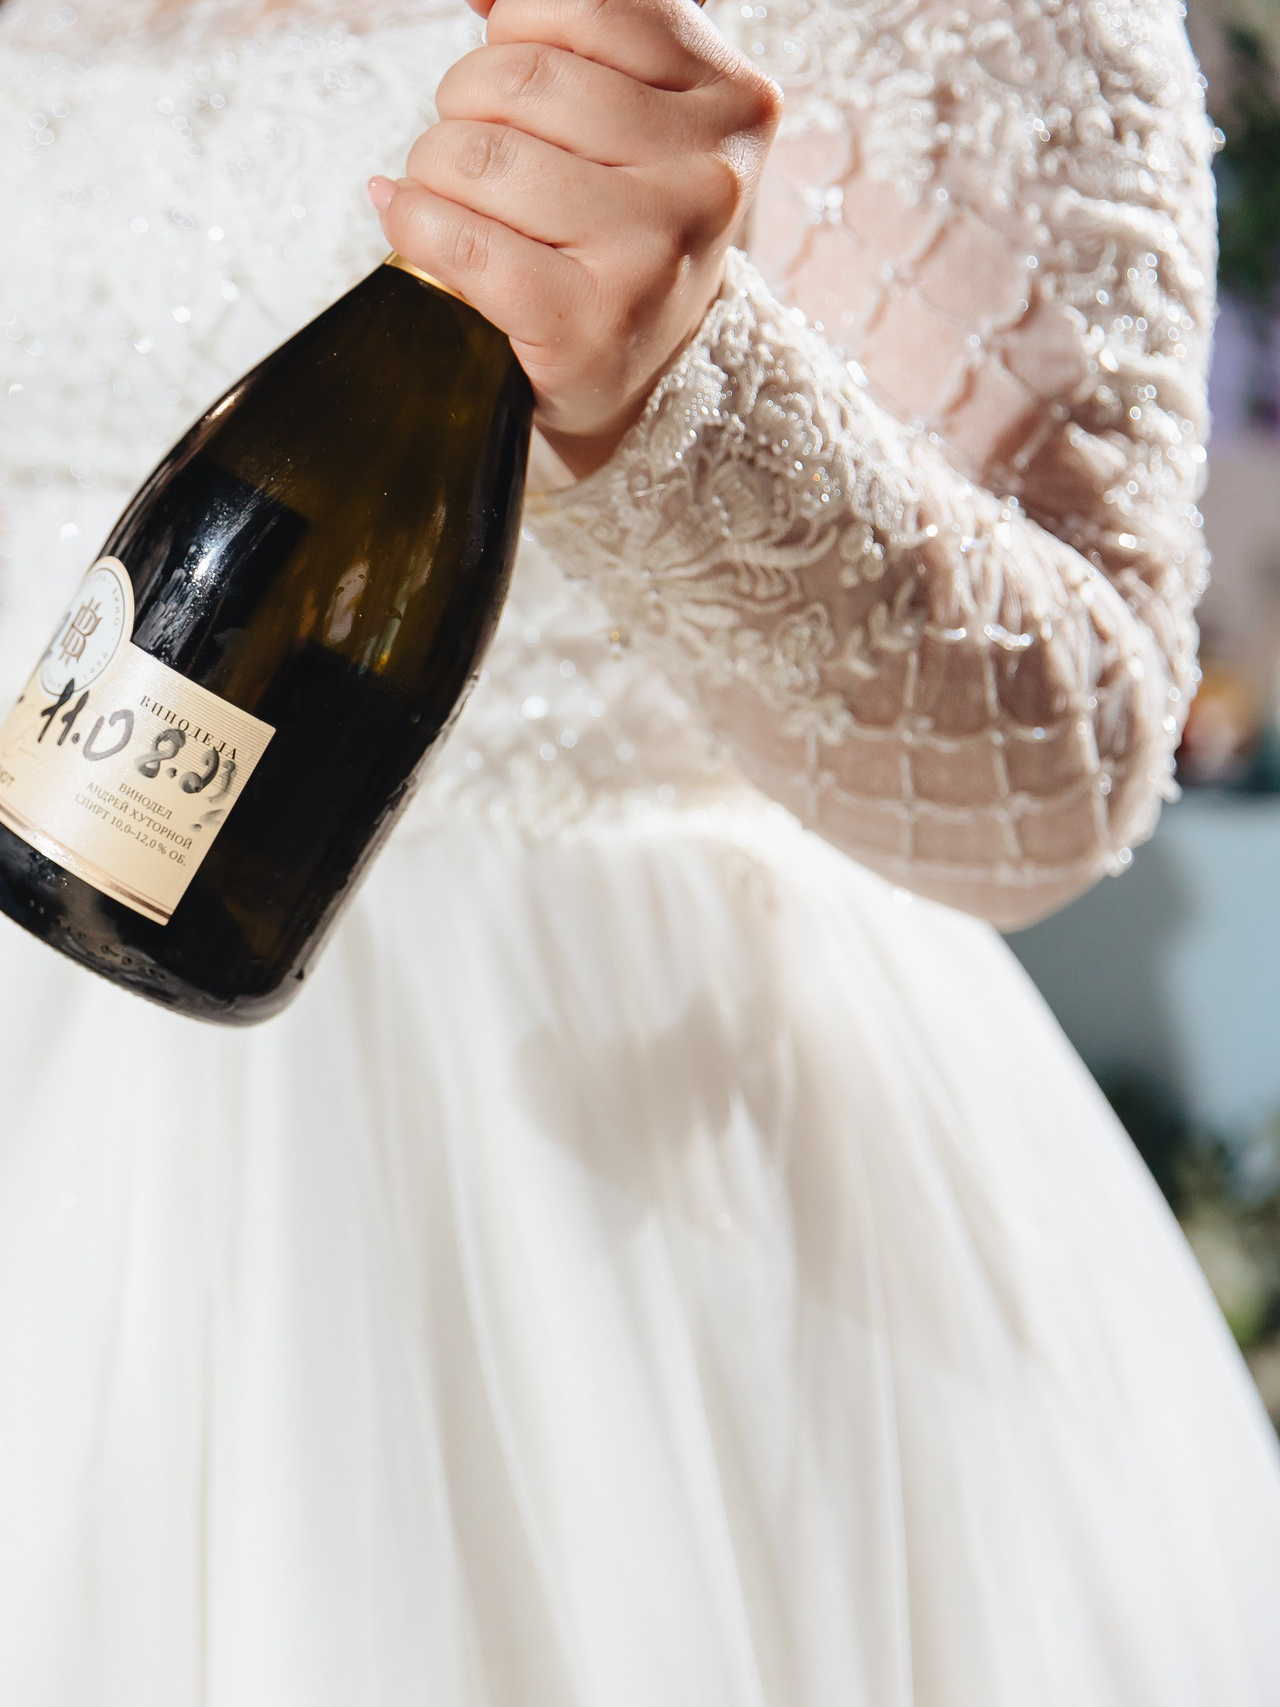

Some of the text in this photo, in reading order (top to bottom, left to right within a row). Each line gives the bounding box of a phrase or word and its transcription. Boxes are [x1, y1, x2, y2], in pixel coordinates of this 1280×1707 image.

[139, 695, 238, 761] ВИНОДЕЛА
[75, 793, 111, 820] СПИРТ
[169, 849, 187, 867] ОБ.
[86, 781, 194, 850] АНДРЕЙ ХУТОРНОЙ
[118, 782, 173, 820] ВИНОДЕЛ
